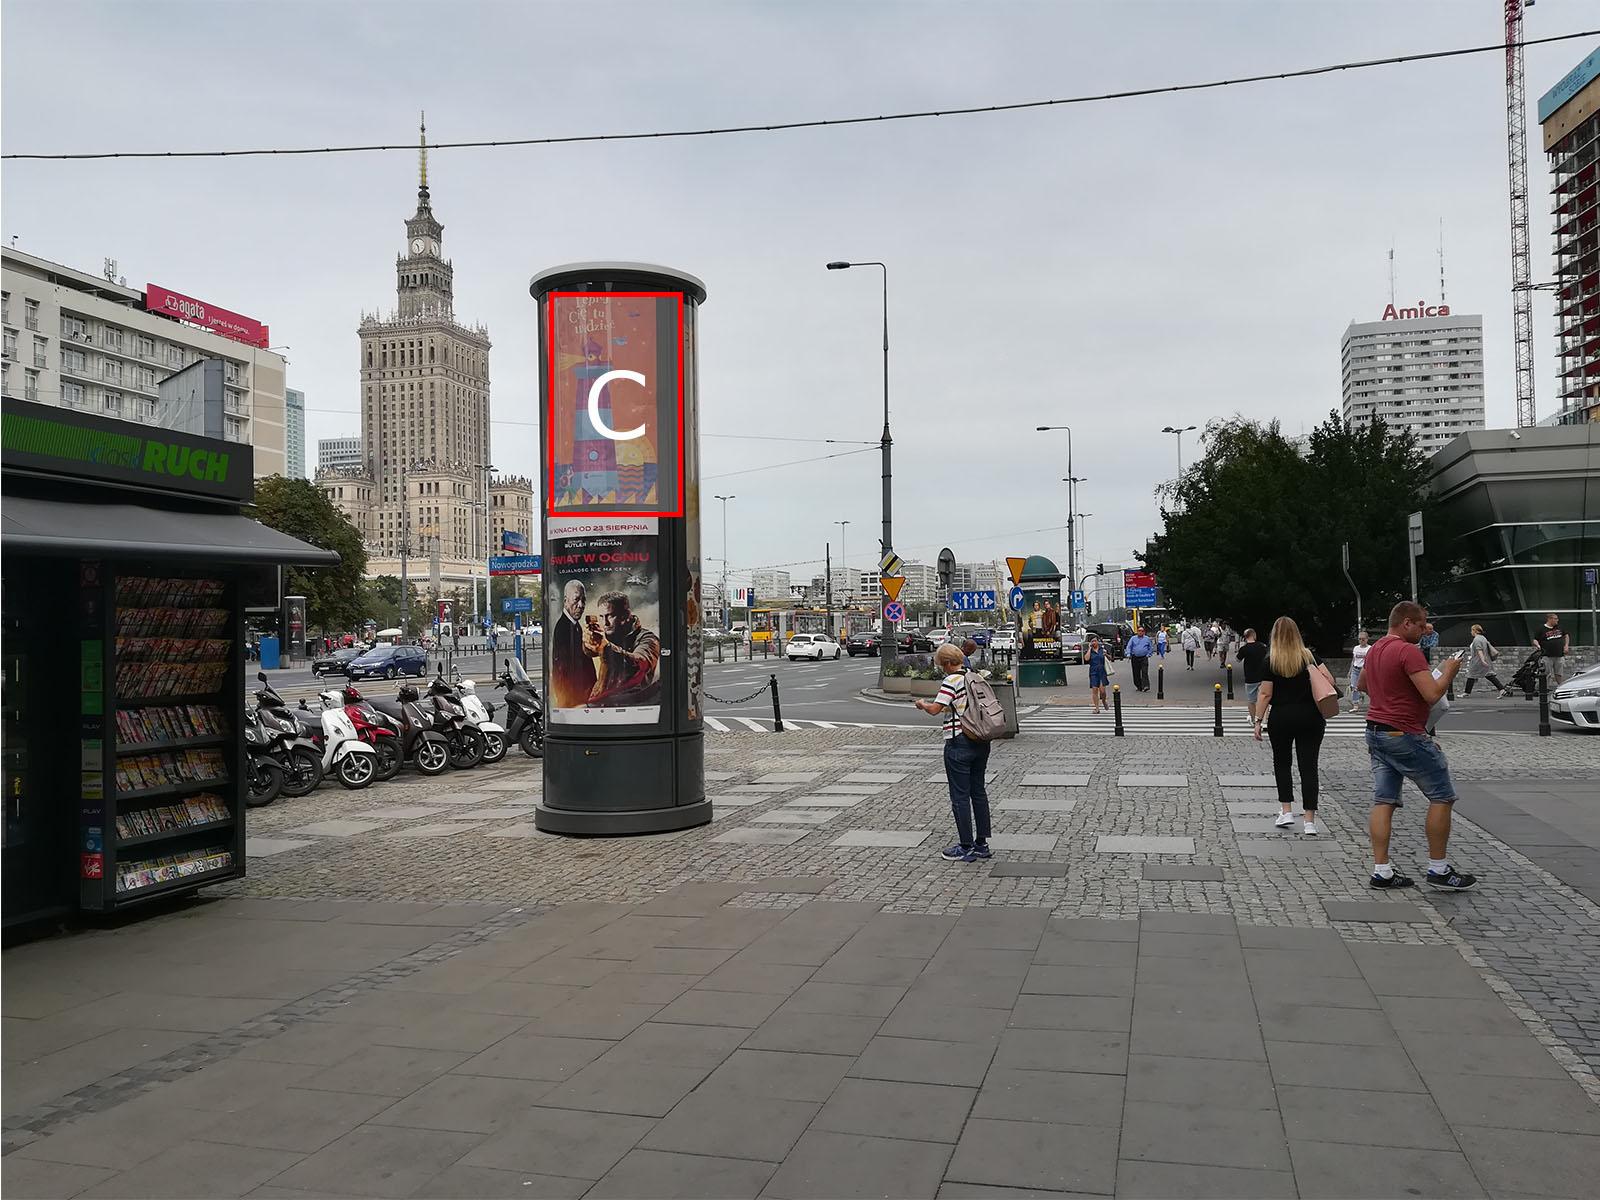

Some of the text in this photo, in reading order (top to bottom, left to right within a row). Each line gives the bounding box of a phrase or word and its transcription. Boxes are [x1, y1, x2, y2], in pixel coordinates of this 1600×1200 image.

[179, 299, 204, 320] agata
[593, 308, 605, 319] tu
[1382, 300, 1450, 321] Amica
[143, 440, 229, 483] RUCH
[554, 526, 578, 535] KINACH
[583, 553, 595, 563] W
[598, 552, 650, 563] OGNIU
[491, 560, 539, 570] Nowogrodzka
[1075, 592, 1082, 603] P
